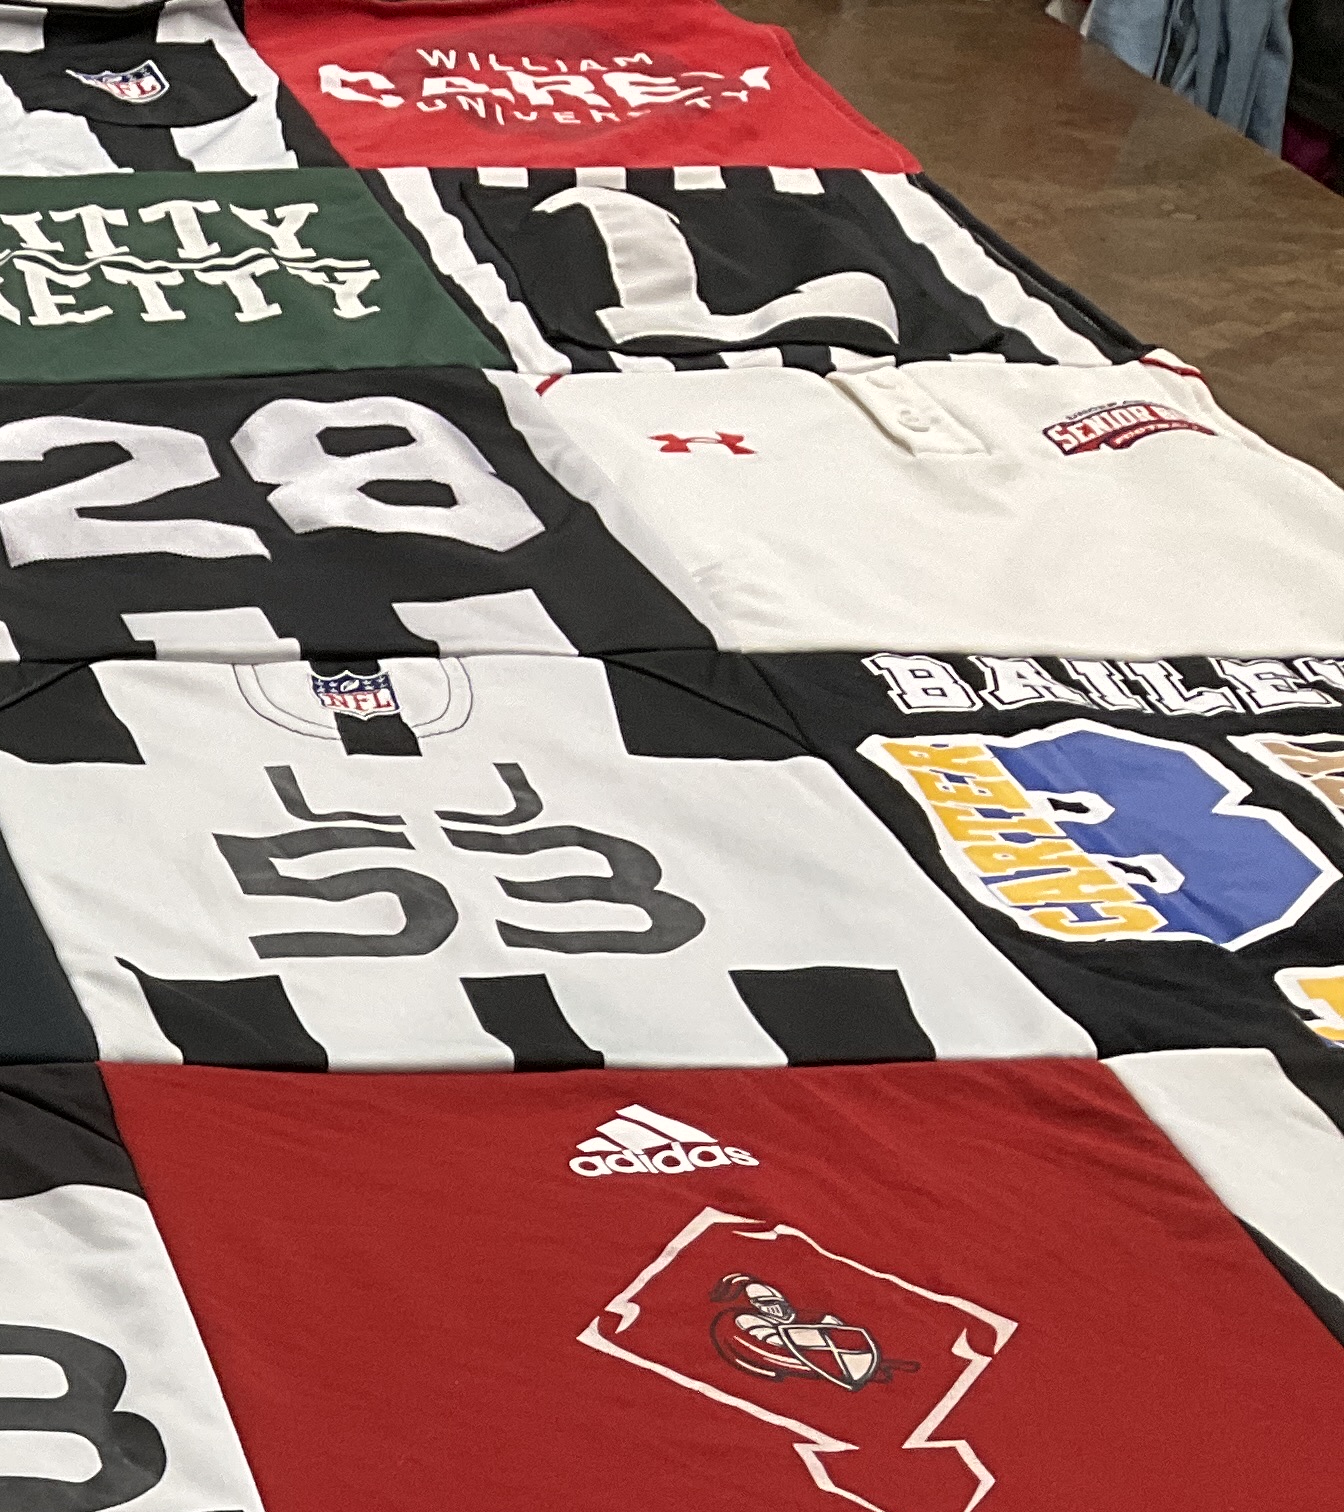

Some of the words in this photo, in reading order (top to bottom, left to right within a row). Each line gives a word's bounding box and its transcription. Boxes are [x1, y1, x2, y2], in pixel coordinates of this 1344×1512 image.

[416, 48, 654, 72] WILLIAM
[416, 89, 749, 126] UNIVERTY
[1047, 404, 1160, 452] SENIOR
[324, 690, 393, 711] NFL
[264, 763, 544, 827] LJ
[880, 742, 1169, 936] CARTER
[212, 825, 707, 960] 53
[568, 1142, 760, 1177] adidas
